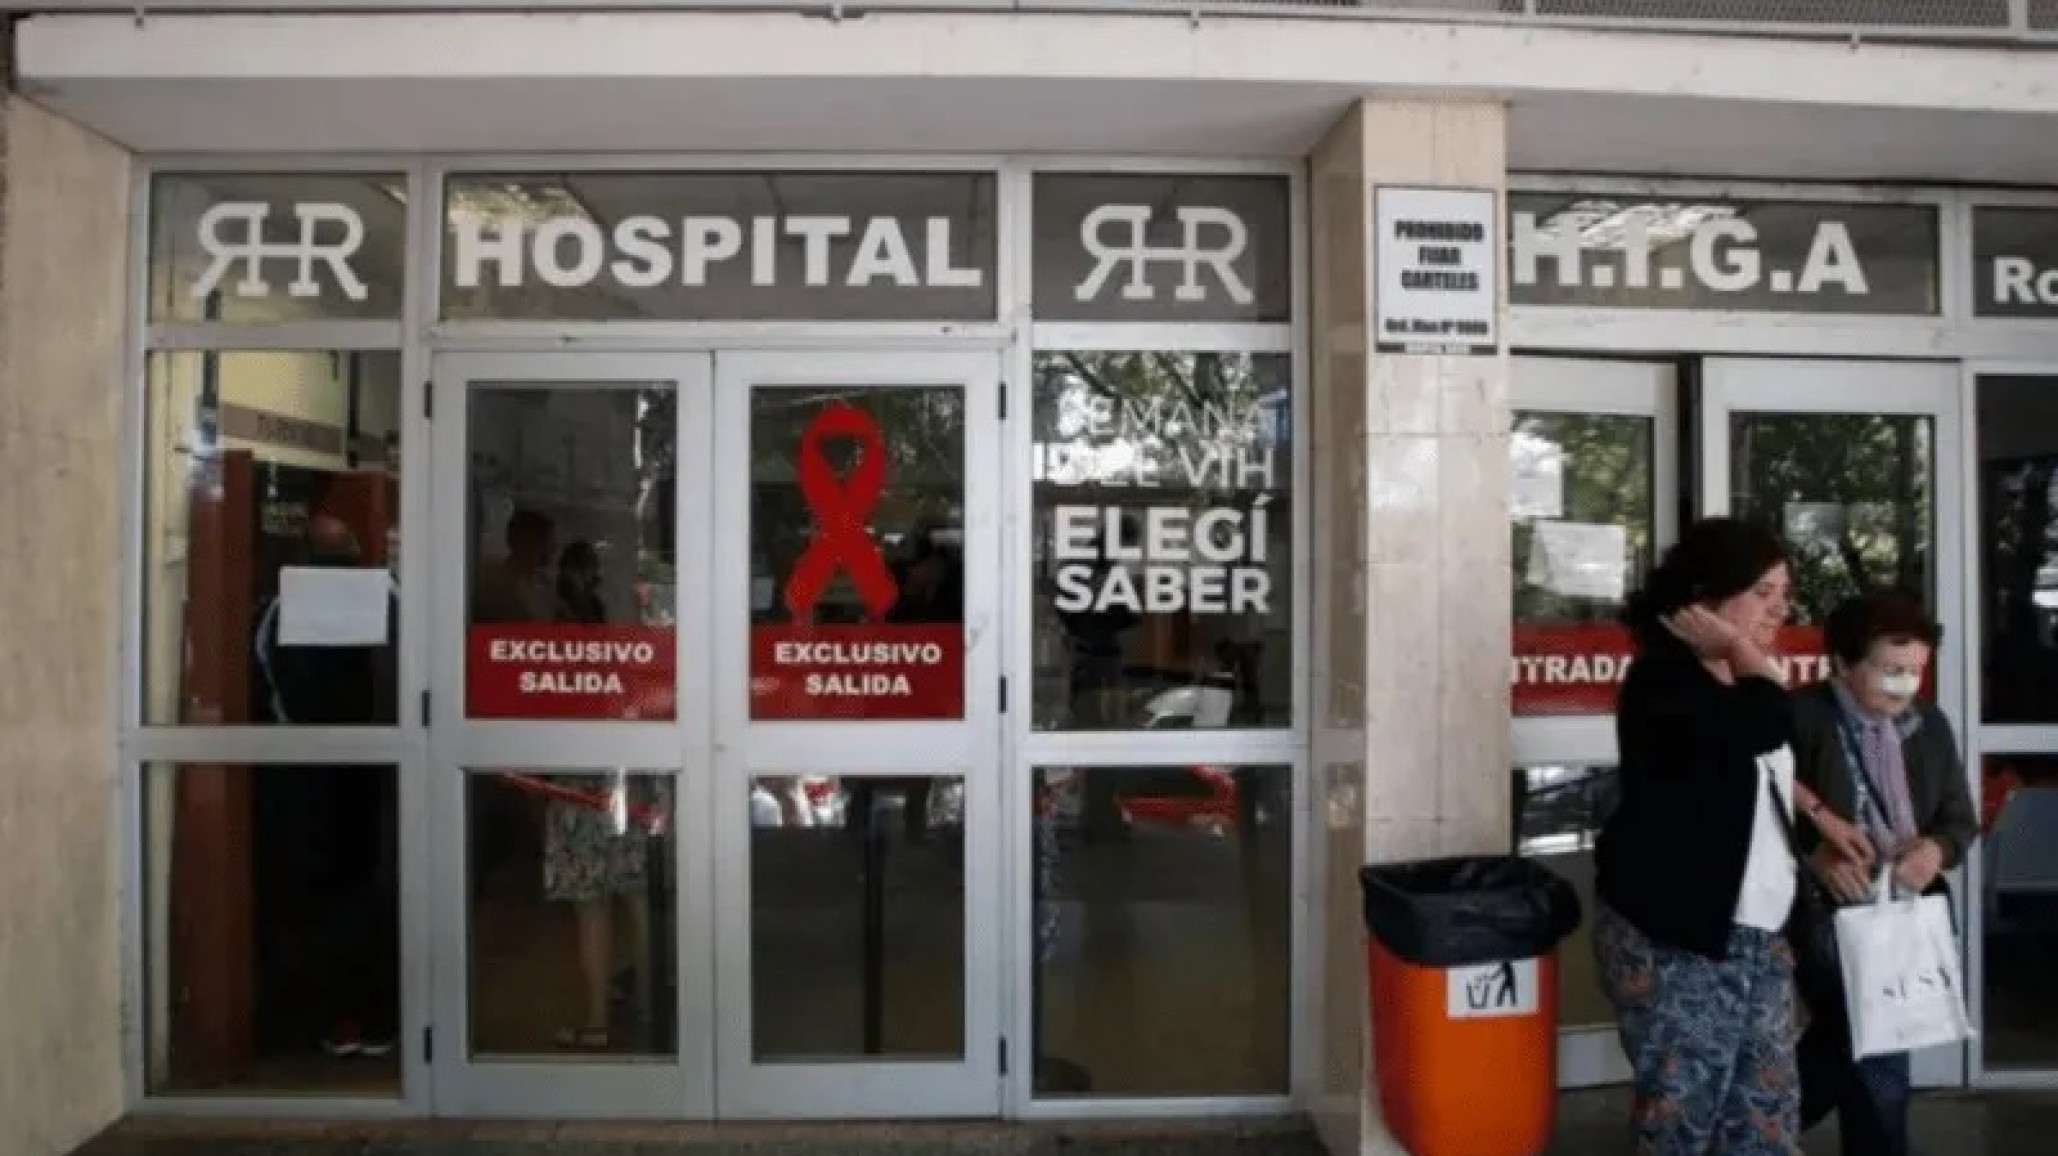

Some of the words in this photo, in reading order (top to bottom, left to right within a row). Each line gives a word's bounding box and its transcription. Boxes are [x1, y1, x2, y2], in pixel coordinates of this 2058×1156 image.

[454, 215, 983, 287] HOSPITAL
[1179, 447, 1274, 488] VIH
[1055, 494, 1270, 562] ELEGÍ
[1054, 565, 1271, 614] SABER
[490, 640, 654, 663] EXCLUSIVO
[774, 642, 942, 664] EXCLUSIVO
[519, 672, 624, 694] SALIDA
[804, 675, 912, 696] SALIDA
